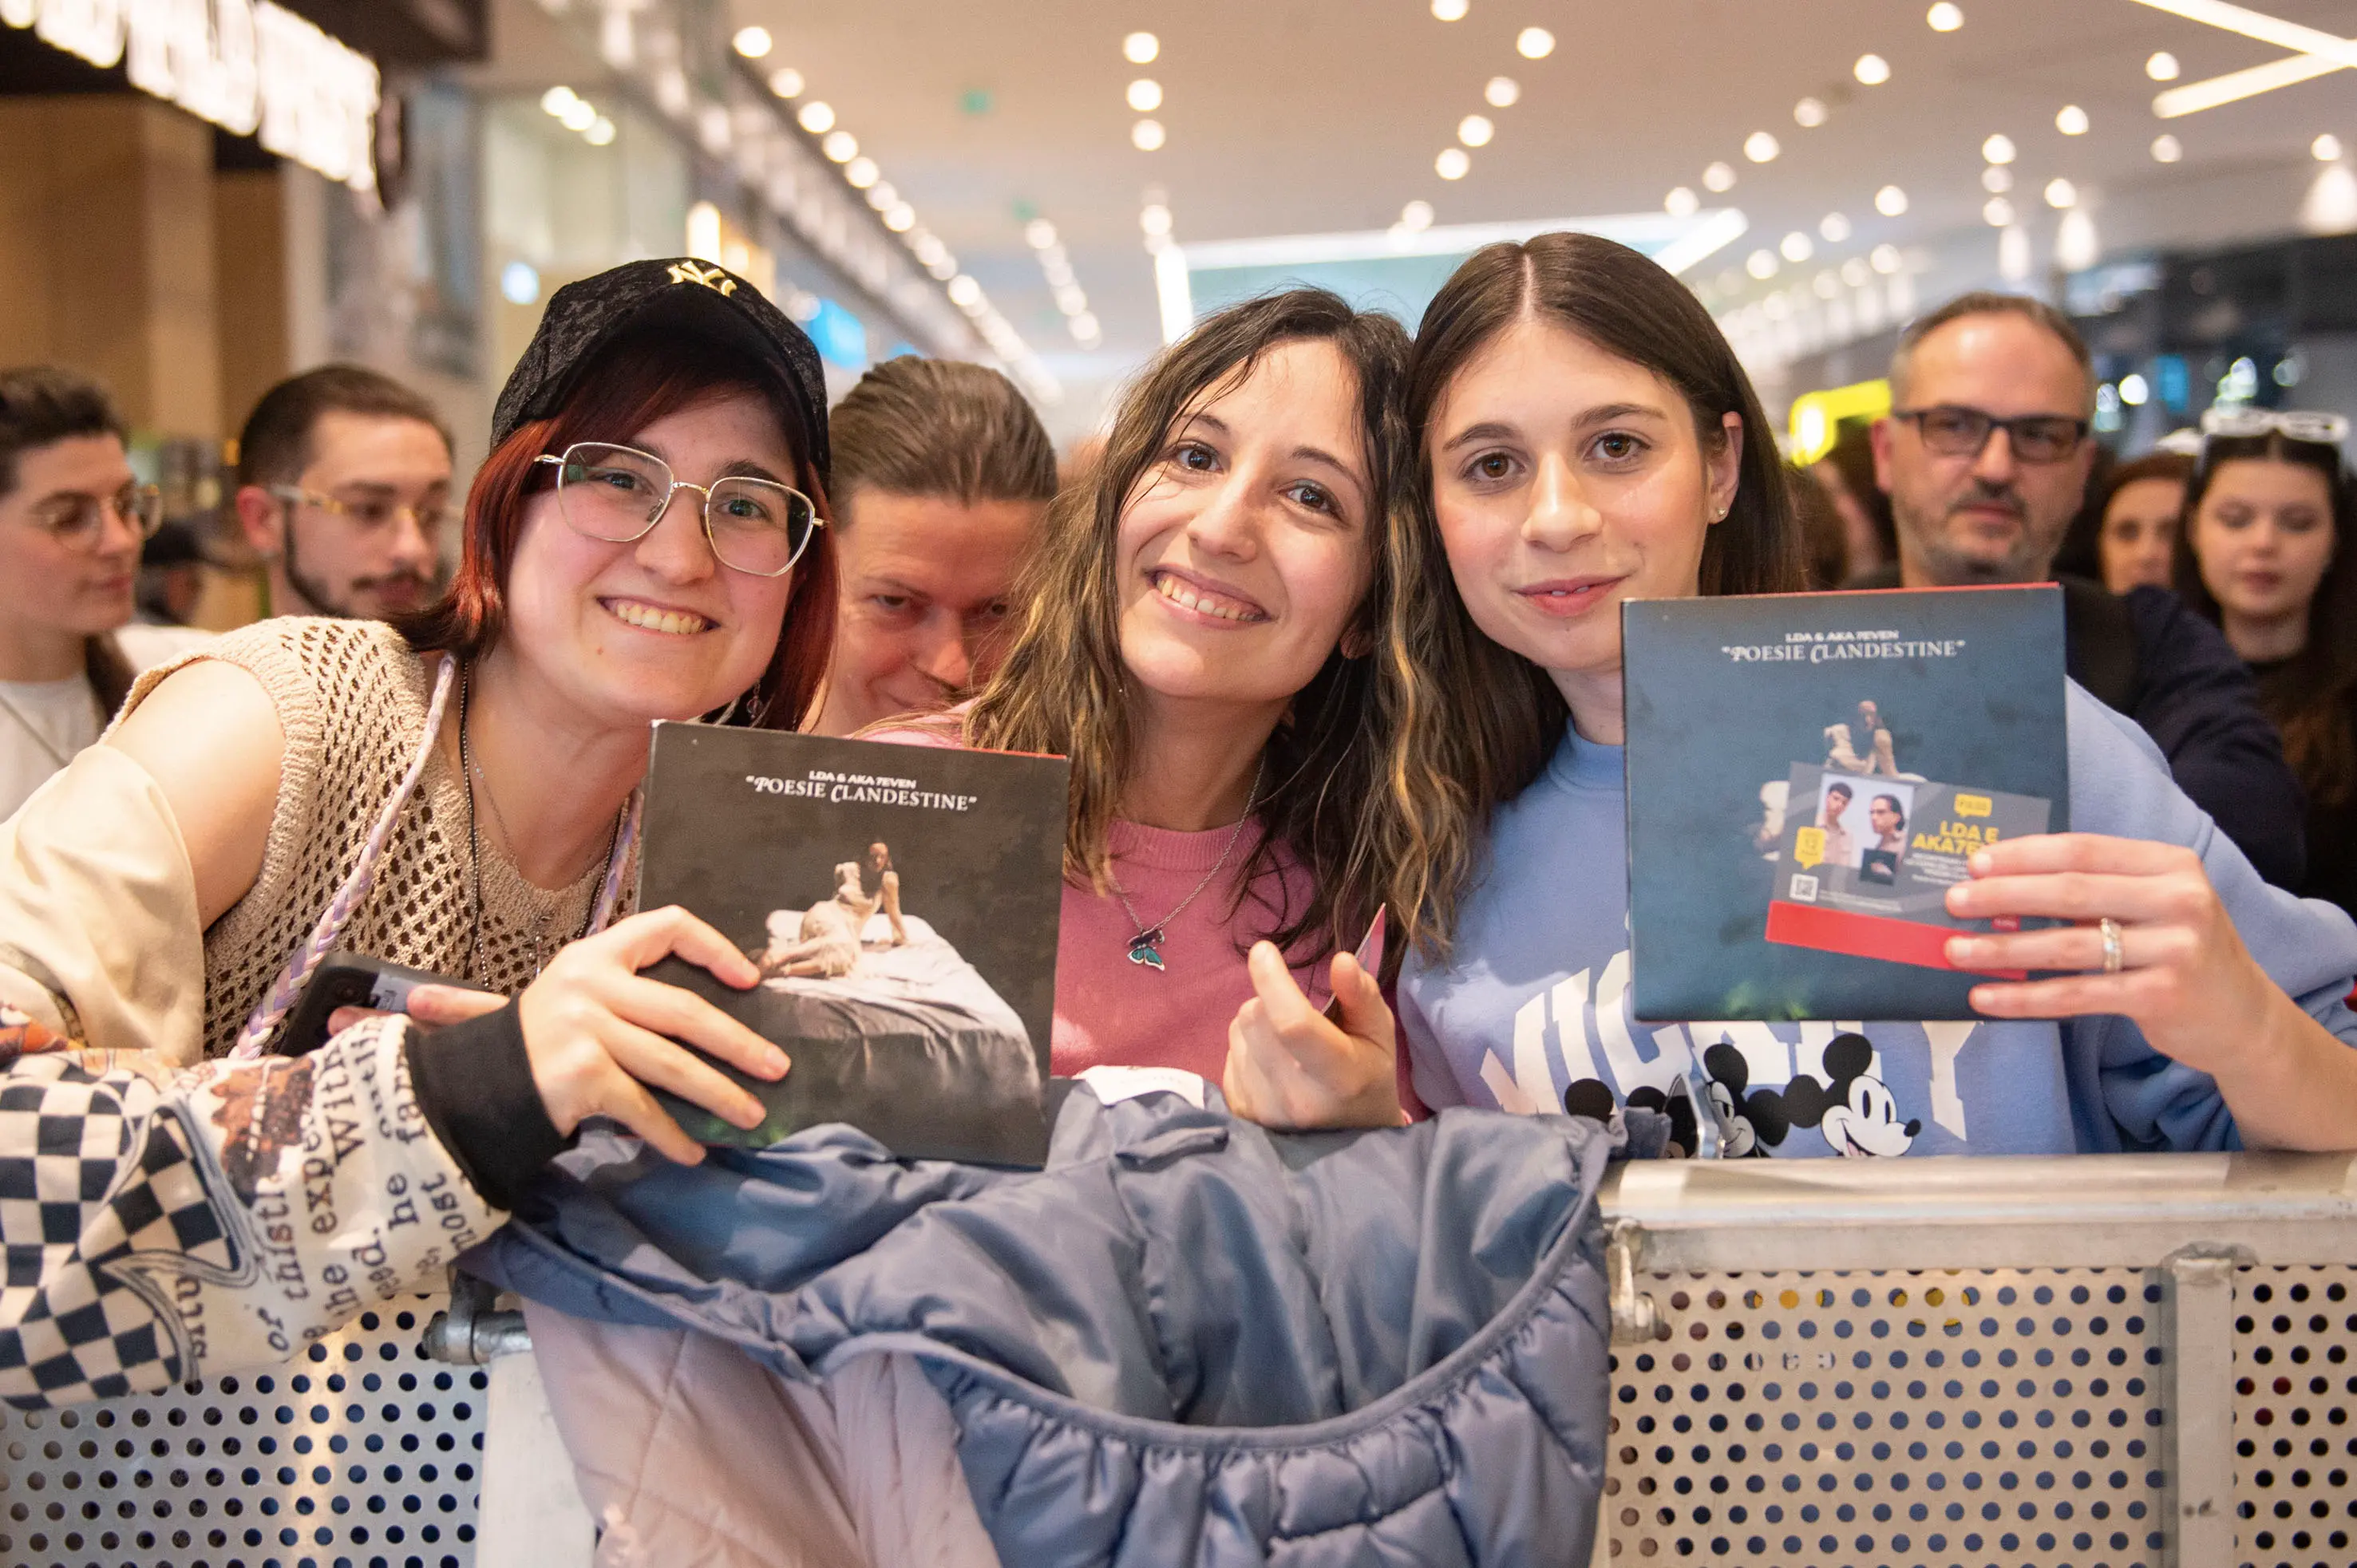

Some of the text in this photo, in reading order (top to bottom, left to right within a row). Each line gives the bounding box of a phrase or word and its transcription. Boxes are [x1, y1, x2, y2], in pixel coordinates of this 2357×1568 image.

[1785, 632, 1813, 643] LDA
[1812, 632, 1825, 642] &
[1825, 631, 1857, 642] AKA
[809, 770, 917, 790] LDA & AKA 7EVEN
[1940, 820, 1999, 844] LDA E
[387, 1173, 419, 1231] he
